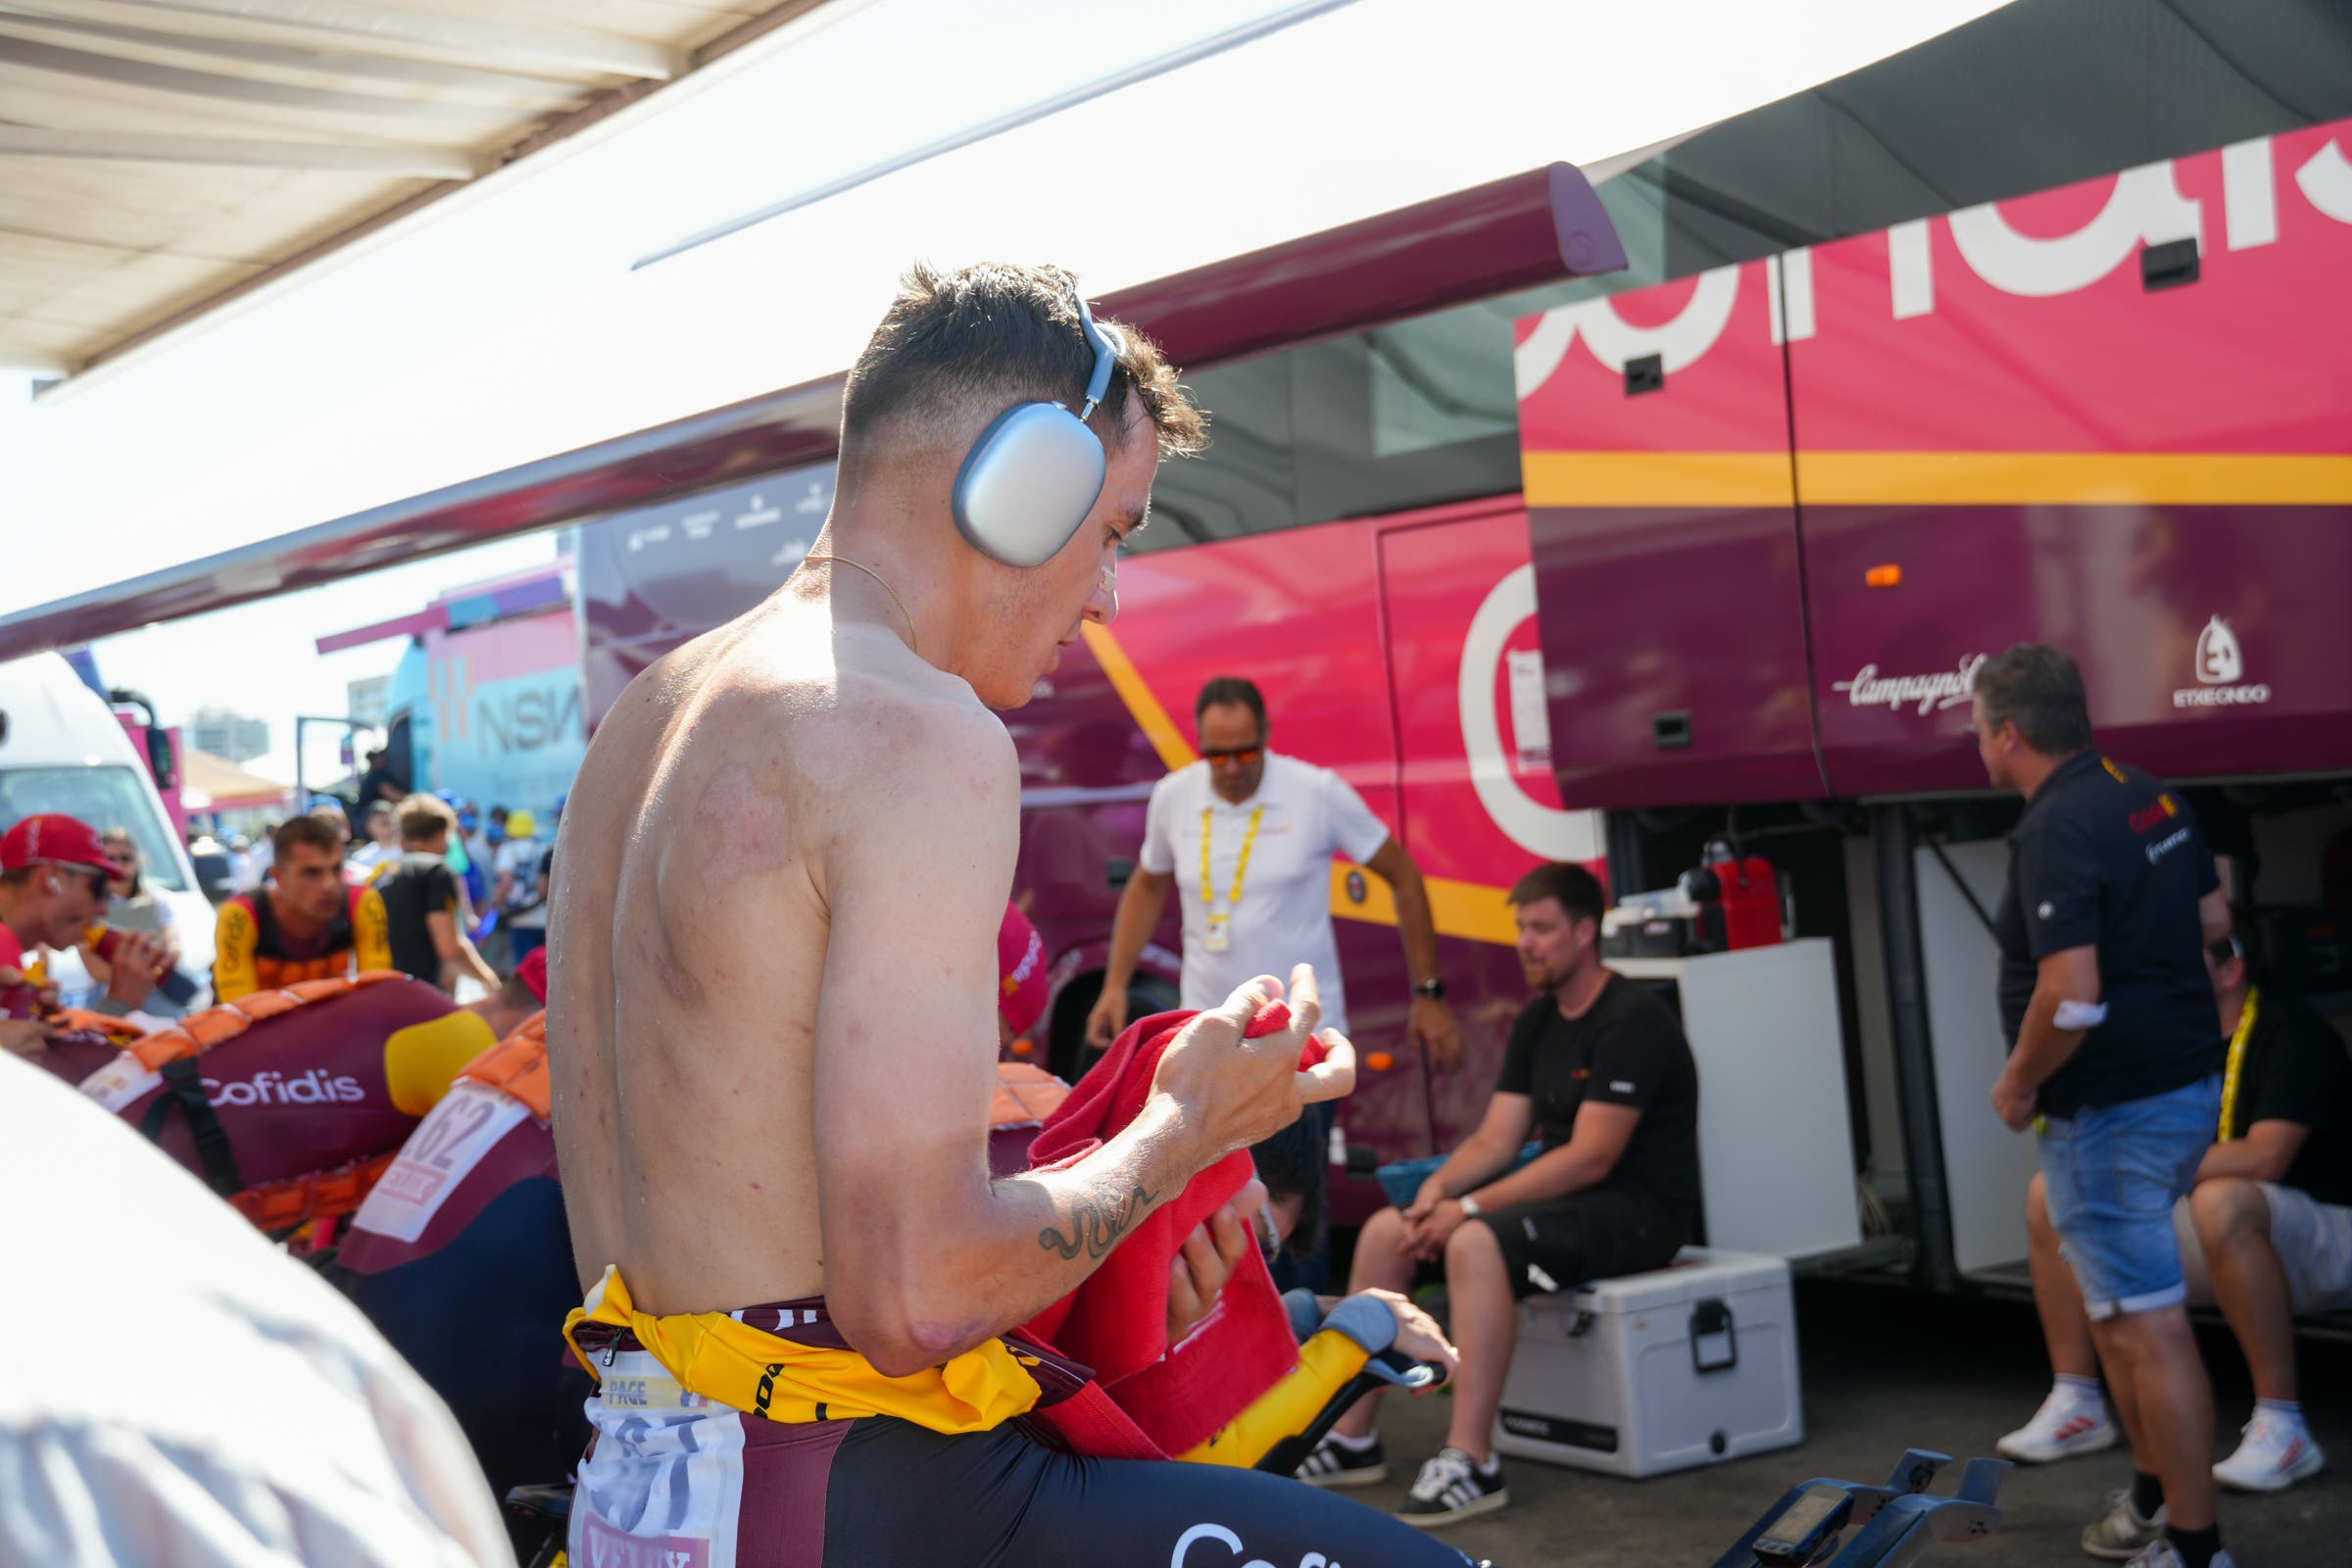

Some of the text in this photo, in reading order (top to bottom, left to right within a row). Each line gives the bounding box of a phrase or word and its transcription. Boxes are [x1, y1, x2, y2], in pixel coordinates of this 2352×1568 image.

[1832, 652, 1988, 716] Campagnol
[403, 1095, 497, 1171] 62
[608, 1380, 649, 1406] PAGE
